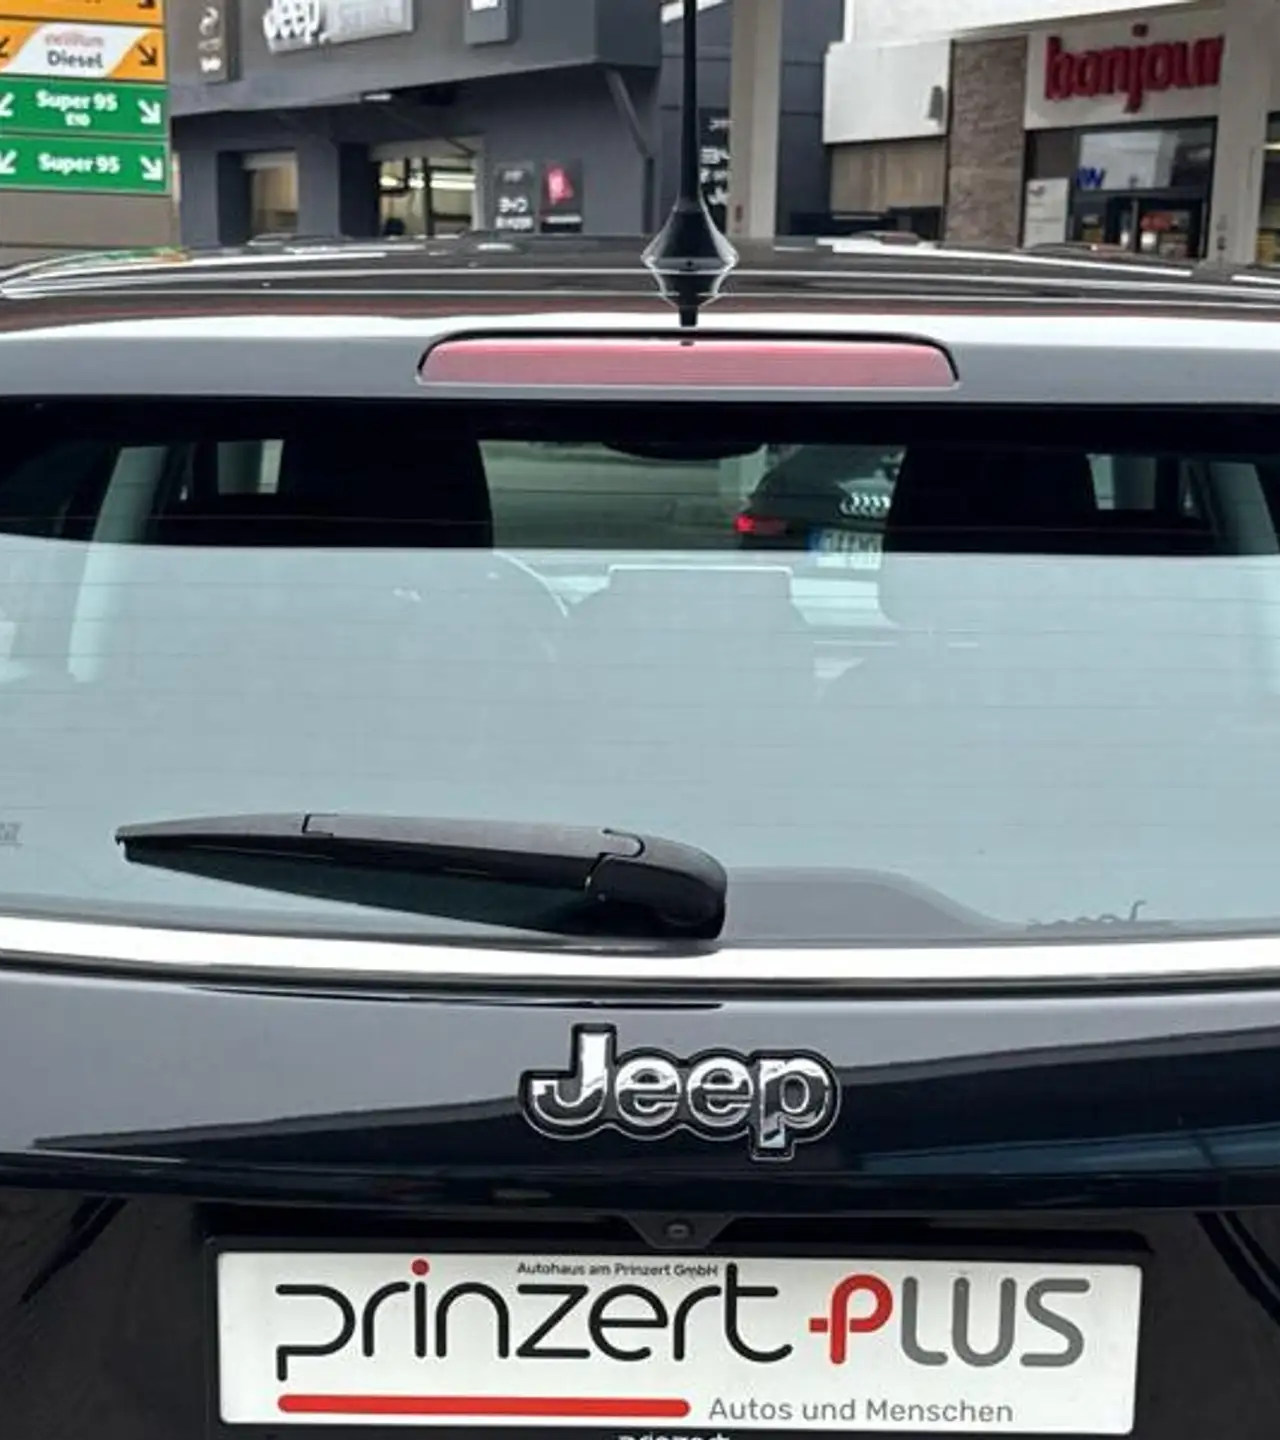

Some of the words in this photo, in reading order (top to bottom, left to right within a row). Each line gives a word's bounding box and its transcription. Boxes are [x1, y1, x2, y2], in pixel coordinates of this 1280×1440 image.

[47, 48, 104, 69] Diesel
[1045, 24, 1225, 114] bonjour
[35, 88, 91, 112] Super
[93, 91, 118, 112] 95
[38, 151, 93, 177] Super
[95, 154, 120, 175] 95
[523, 1026, 838, 1158] Jeep
[517, 1261, 586, 1276] Autohaus
[589, 1265, 610, 1276] am
[615, 1261, 671, 1277] Prinzert
[674, 1264, 719, 1278] GmbH
[276, 1260, 794, 1382] prinzert
[708, 1398, 793, 1422] Autos
[802, 1399, 856, 1422] und
[865, 1399, 1014, 1424] Menschen
